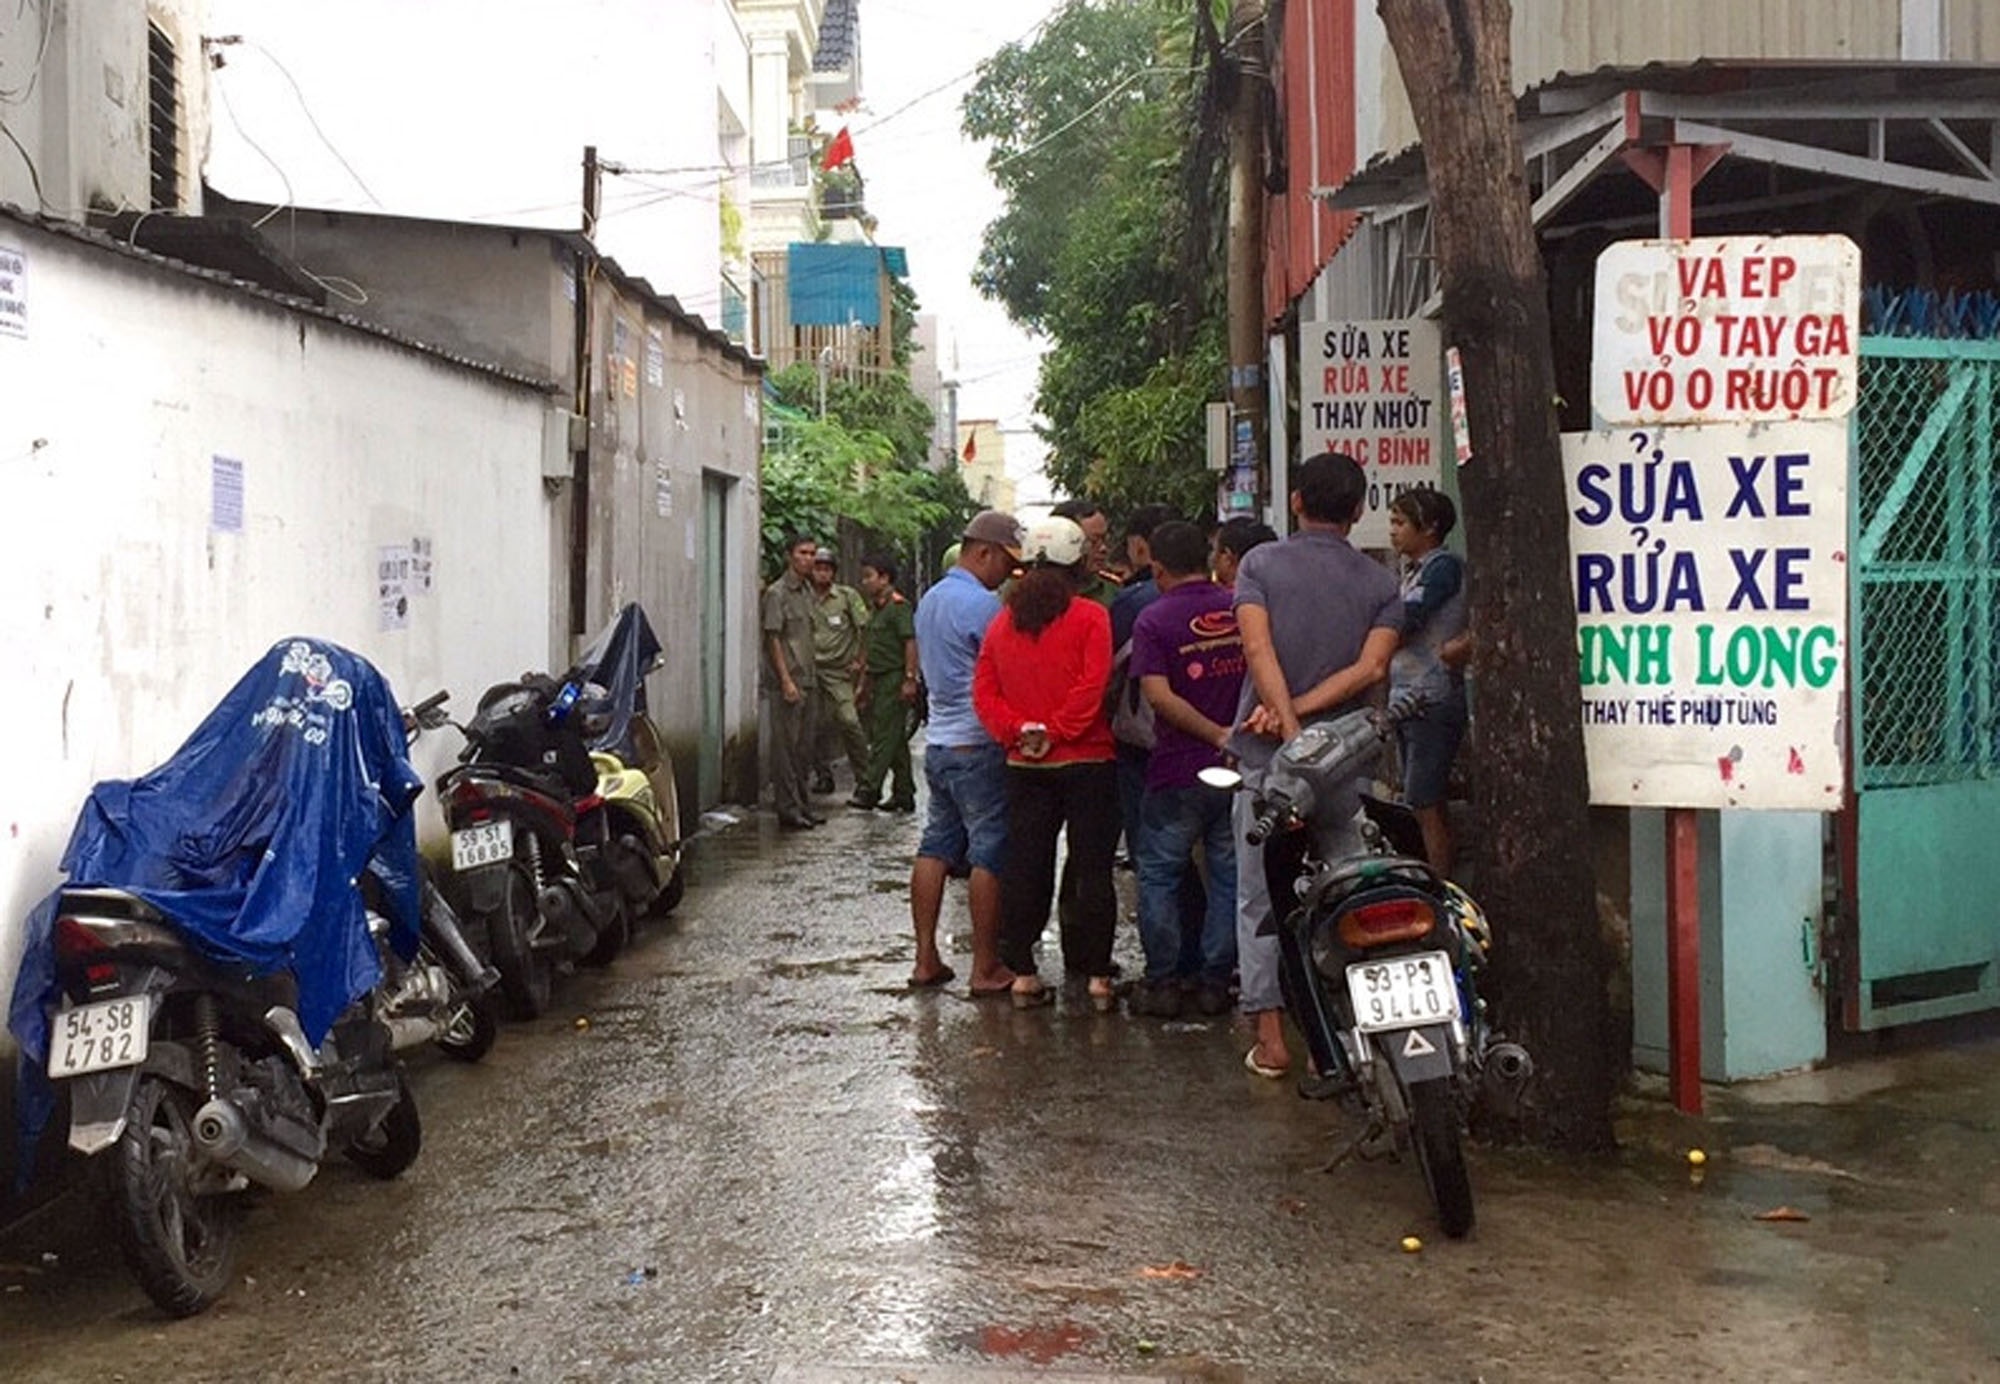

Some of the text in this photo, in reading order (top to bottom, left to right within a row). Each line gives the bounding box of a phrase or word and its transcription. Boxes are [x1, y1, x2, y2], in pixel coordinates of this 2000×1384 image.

[1677, 244, 1727, 298] VÁ
[1741, 244, 1796, 298] ÉP
[1323, 324, 1410, 359] SỬA XE
[1648, 299, 1702, 357] VỎ
[1716, 315, 1787, 357] TAY
[1795, 314, 1850, 357] GA
[1324, 359, 1409, 395] RỬA XE
[1624, 354, 1838, 419] VỎ O RUỘT
[1312, 401, 1366, 430] THAY
[1574, 432, 1811, 527] SỬA XE
[1577, 526, 1811, 615] RỬA XE
[1578, 624, 1838, 689] INH LONG
[1582, 700, 1630, 724] THAY
[66, 1002, 134, 1039] 54-S8
[1370, 989, 1441, 1022] 9440
[64, 1032, 132, 1069] 4782
